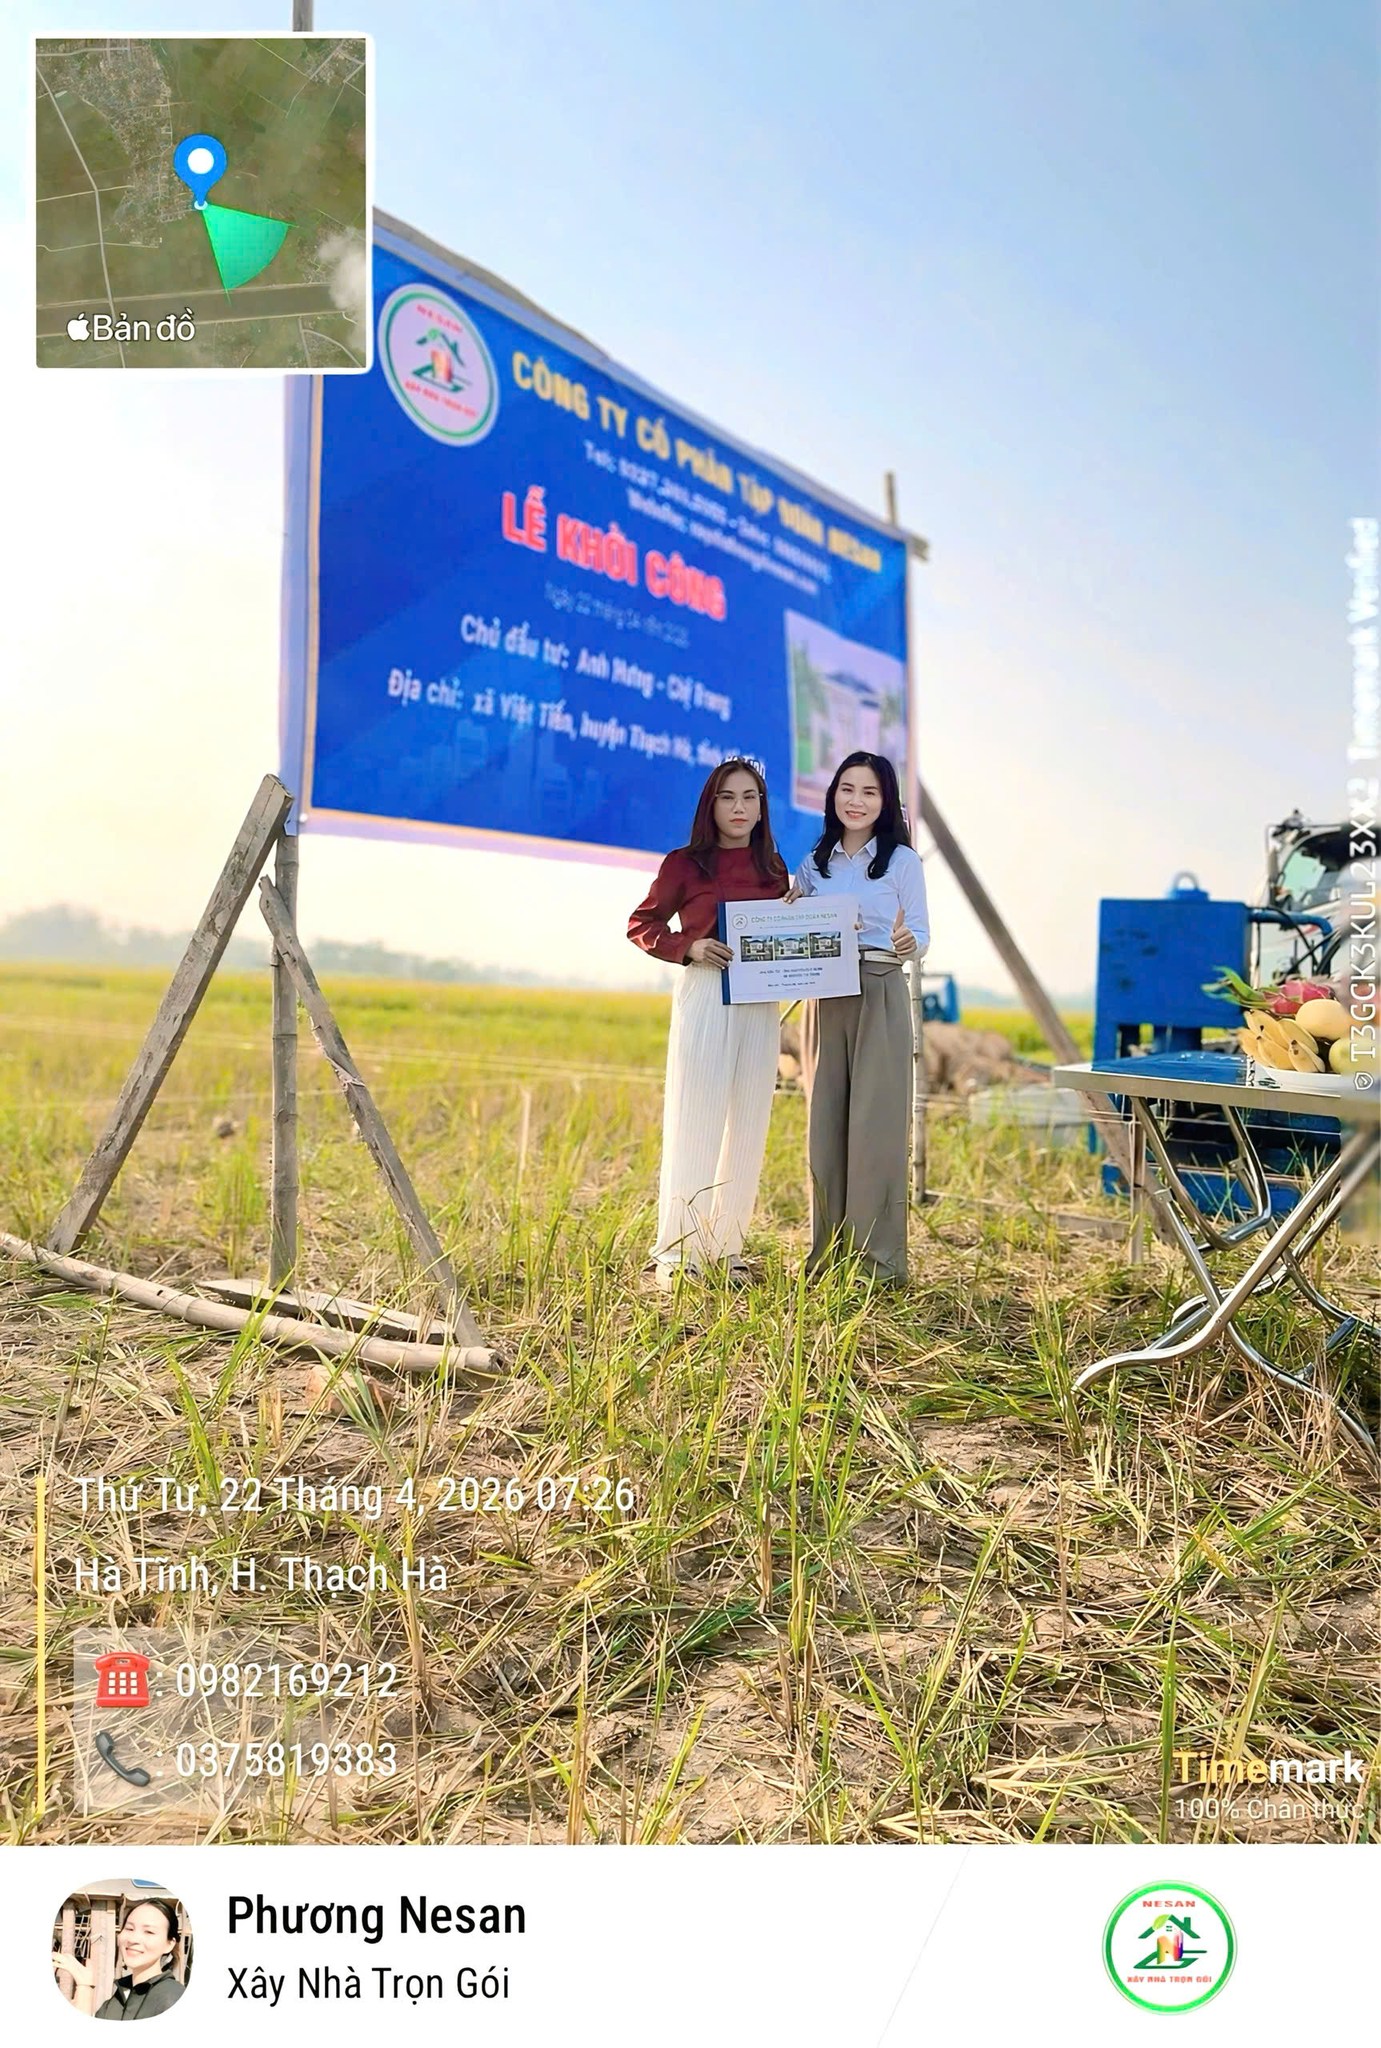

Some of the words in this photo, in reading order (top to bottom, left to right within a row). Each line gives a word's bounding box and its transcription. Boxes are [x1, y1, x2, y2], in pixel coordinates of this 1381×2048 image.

[512, 351, 590, 420] CÔNG
[597, 395, 628, 439] TY
[501, 485, 547, 553] LỄ
[556, 513, 639, 588] KHỞI
[644, 549, 727, 622] CÔNG
[460, 613, 502, 649] Chủ
[576, 647, 610, 681] Anh
[388, 667, 422, 708] Địa
[426, 675, 465, 712] chỉ:
[471, 686, 495, 716] xã
